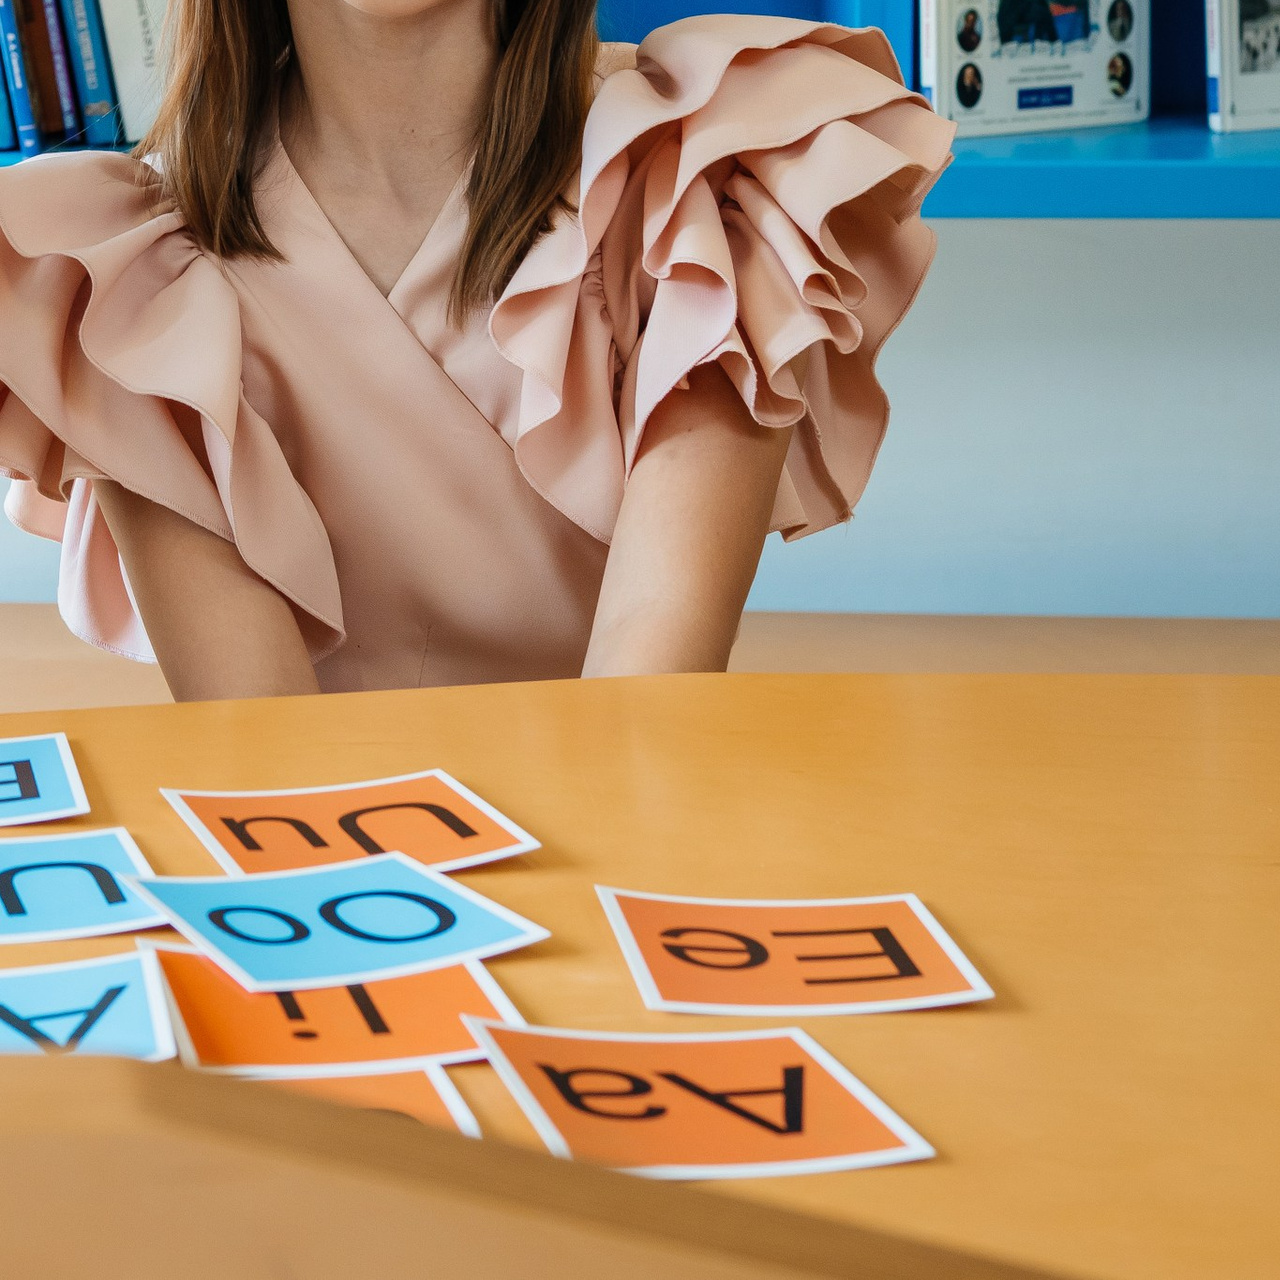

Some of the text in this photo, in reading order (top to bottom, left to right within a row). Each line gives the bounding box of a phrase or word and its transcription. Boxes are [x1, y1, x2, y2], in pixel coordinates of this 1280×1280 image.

[220, 801, 479, 856] Uu
[207, 889, 458, 945] Oo
[660, 927, 923, 986] Ee
[540, 1063, 806, 1136] Aa
